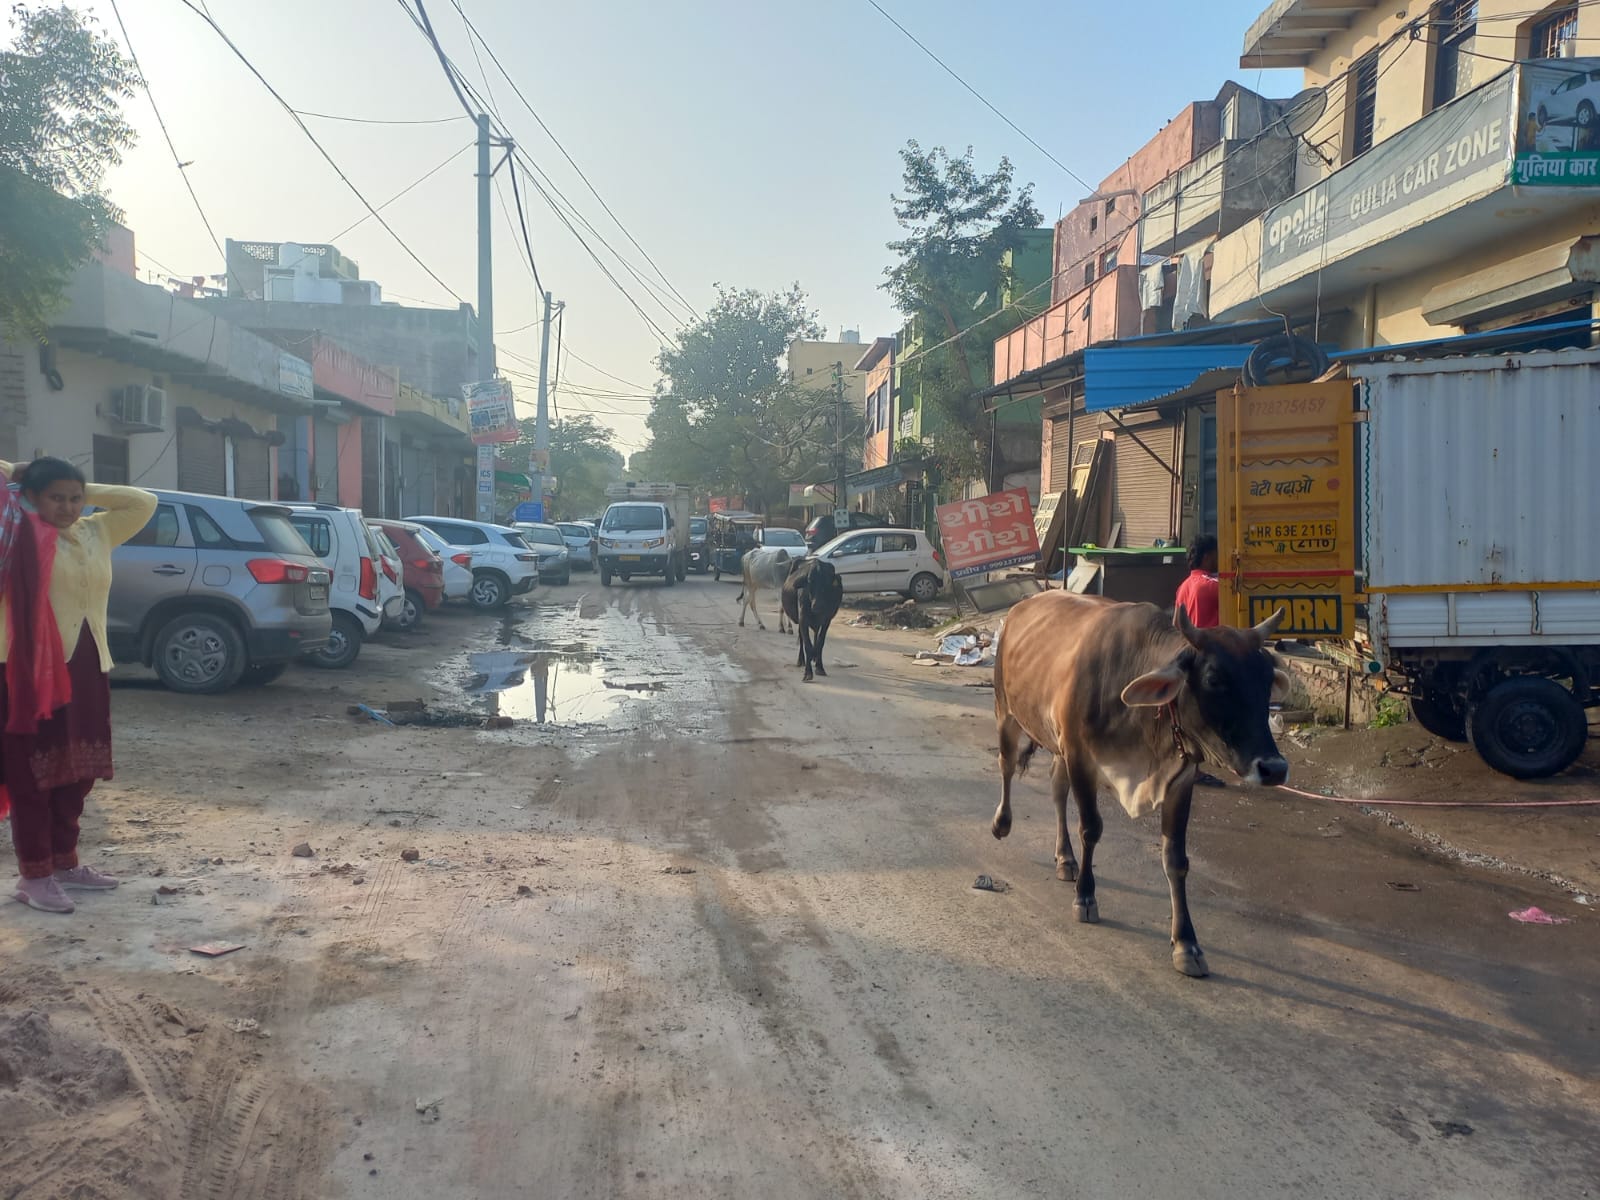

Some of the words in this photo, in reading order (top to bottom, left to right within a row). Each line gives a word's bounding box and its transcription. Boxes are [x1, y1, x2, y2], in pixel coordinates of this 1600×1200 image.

[1350, 174, 1398, 220] GULIA
[1402, 152, 1440, 194] CAR
[1444, 118, 1502, 176] ZONE
[1516, 154, 1567, 183] गुलिया
[1569, 158, 1599, 176] कार
[1269, 188, 1329, 254] apollo
[1257, 526, 1271, 538] HR
[1275, 525, 1297, 537] 63E
[1302, 524, 1332, 537] 2116
